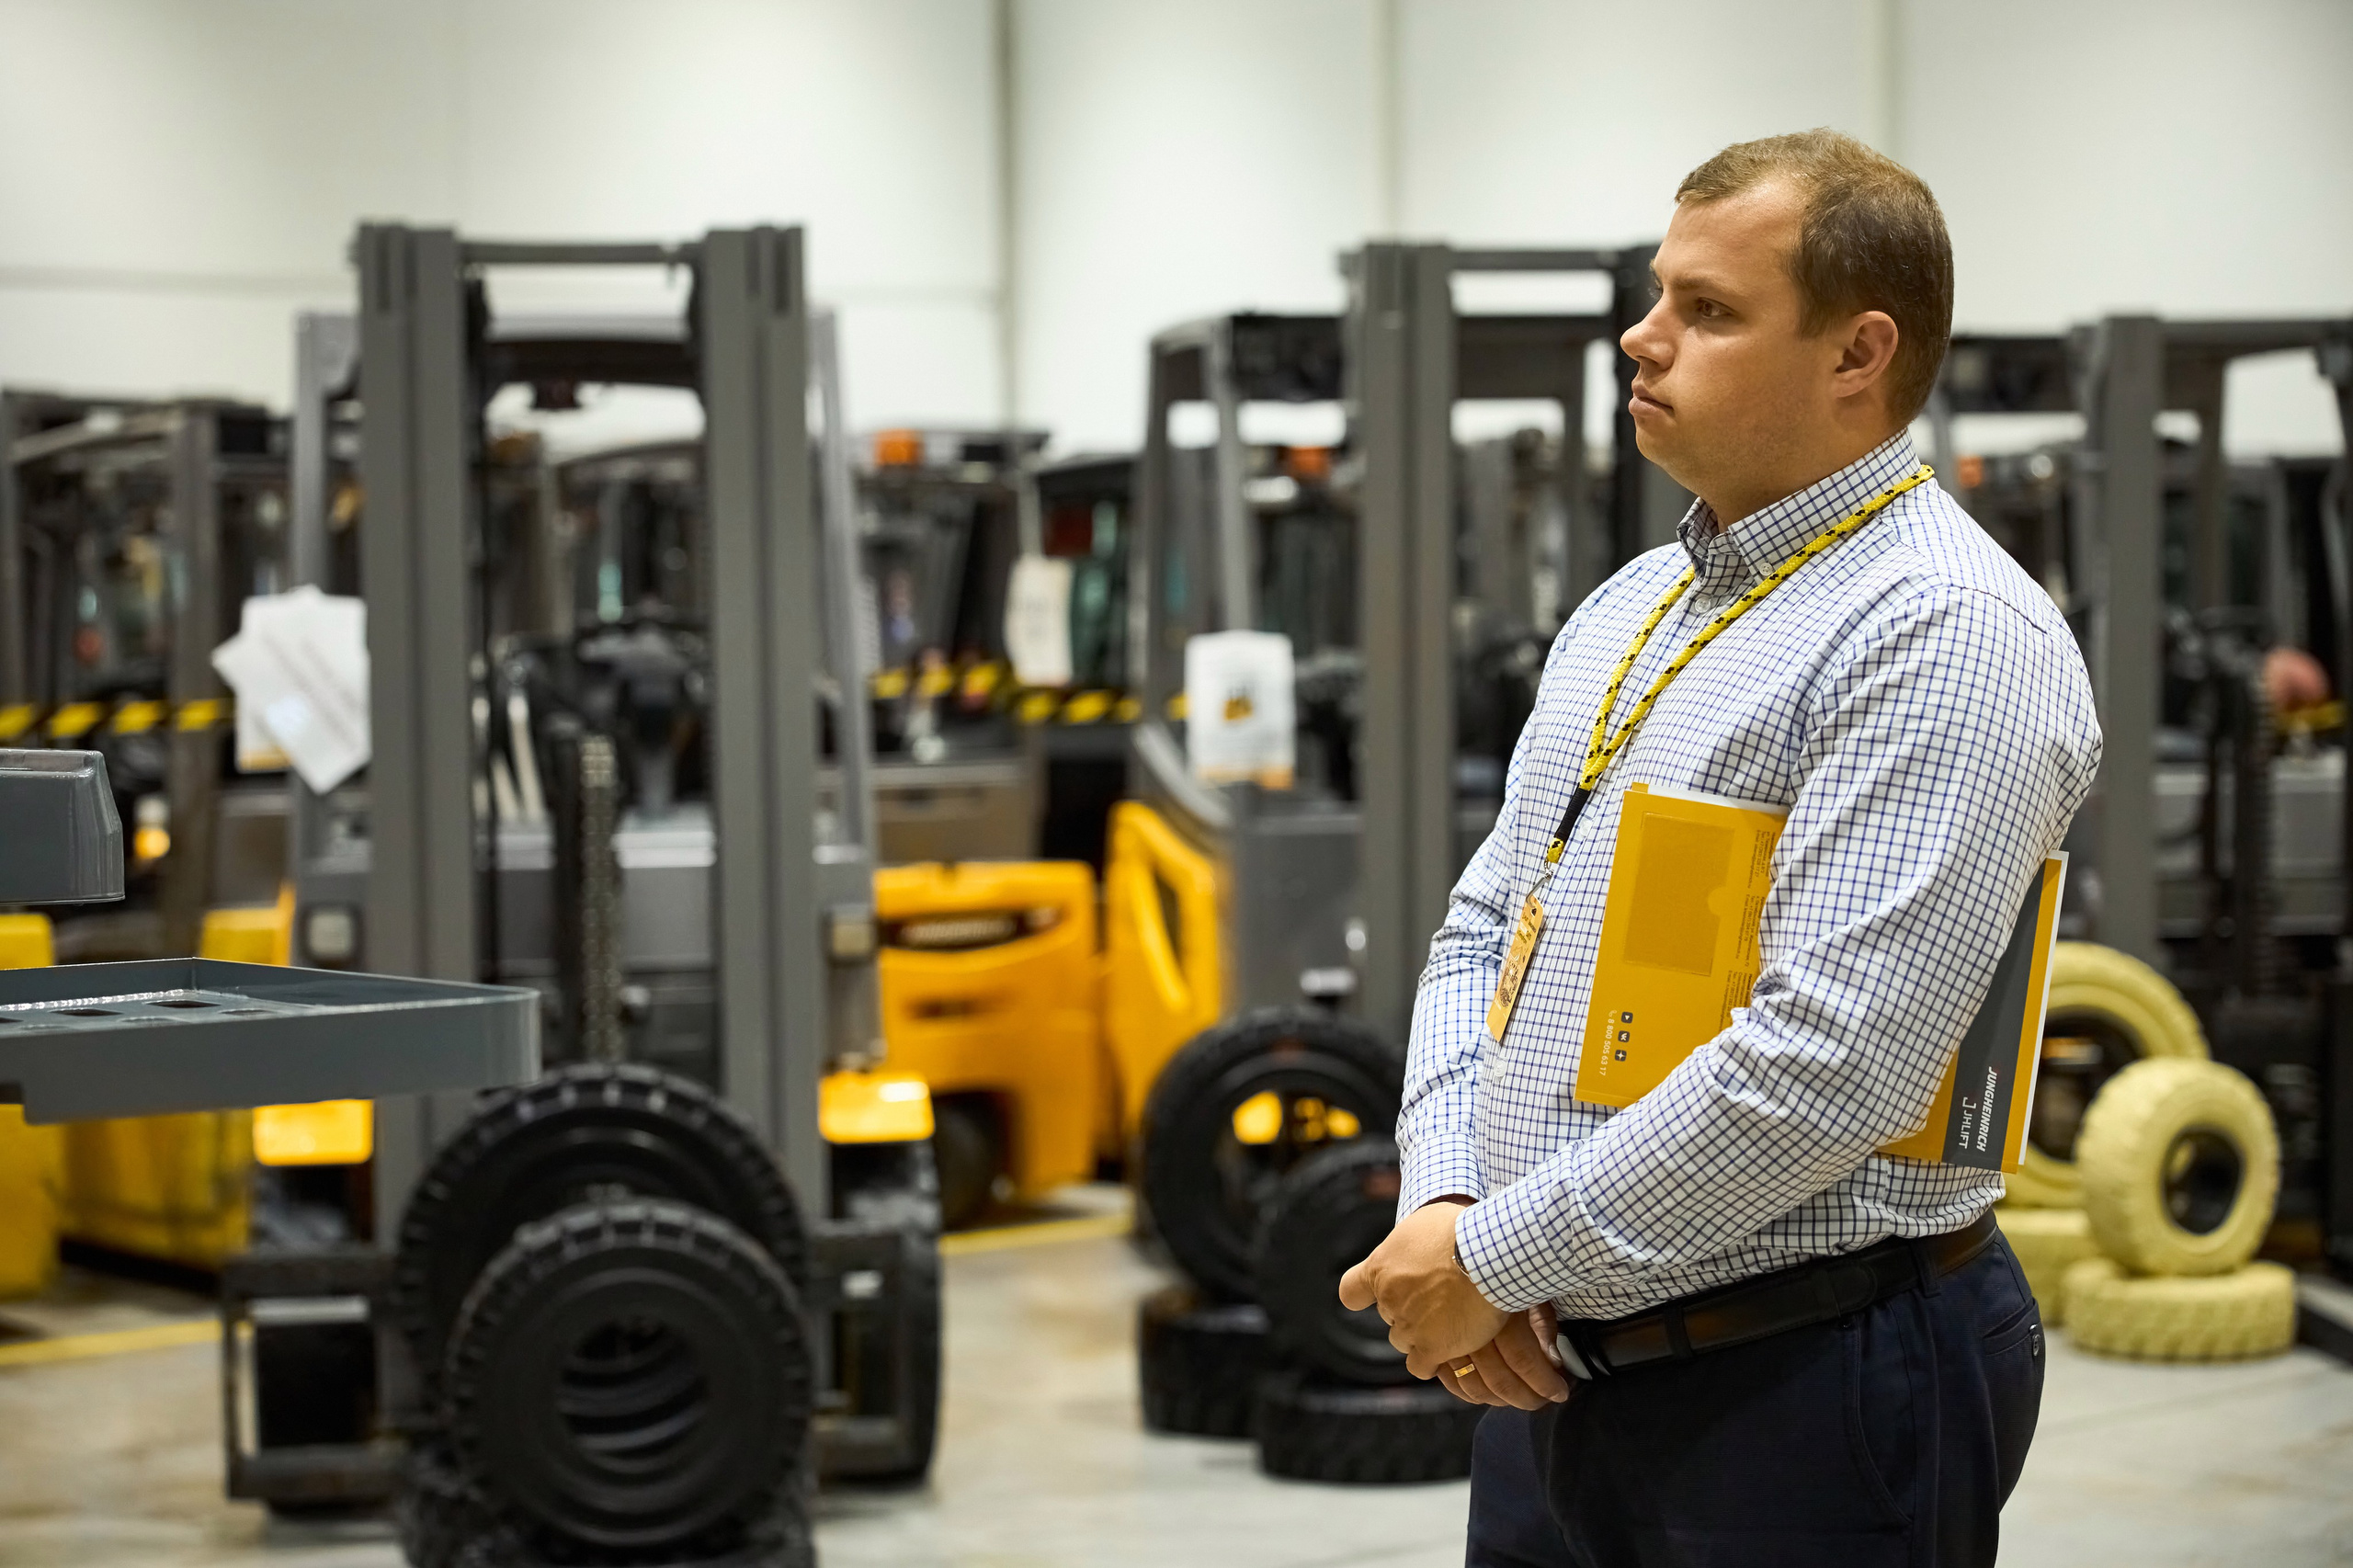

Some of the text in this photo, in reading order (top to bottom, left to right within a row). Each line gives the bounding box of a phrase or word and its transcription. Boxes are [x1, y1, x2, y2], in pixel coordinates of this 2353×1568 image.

[1605, 1025, 1613, 1039] 800
[1602, 1040, 1610, 1054] 505
[1600, 1055, 1608, 1064] 63
[1599, 1067, 1607, 1075] 17
[1976, 1066, 1998, 1152] JUNGHEINRICH
[1959, 1110, 1972, 1149] JHLIFT
